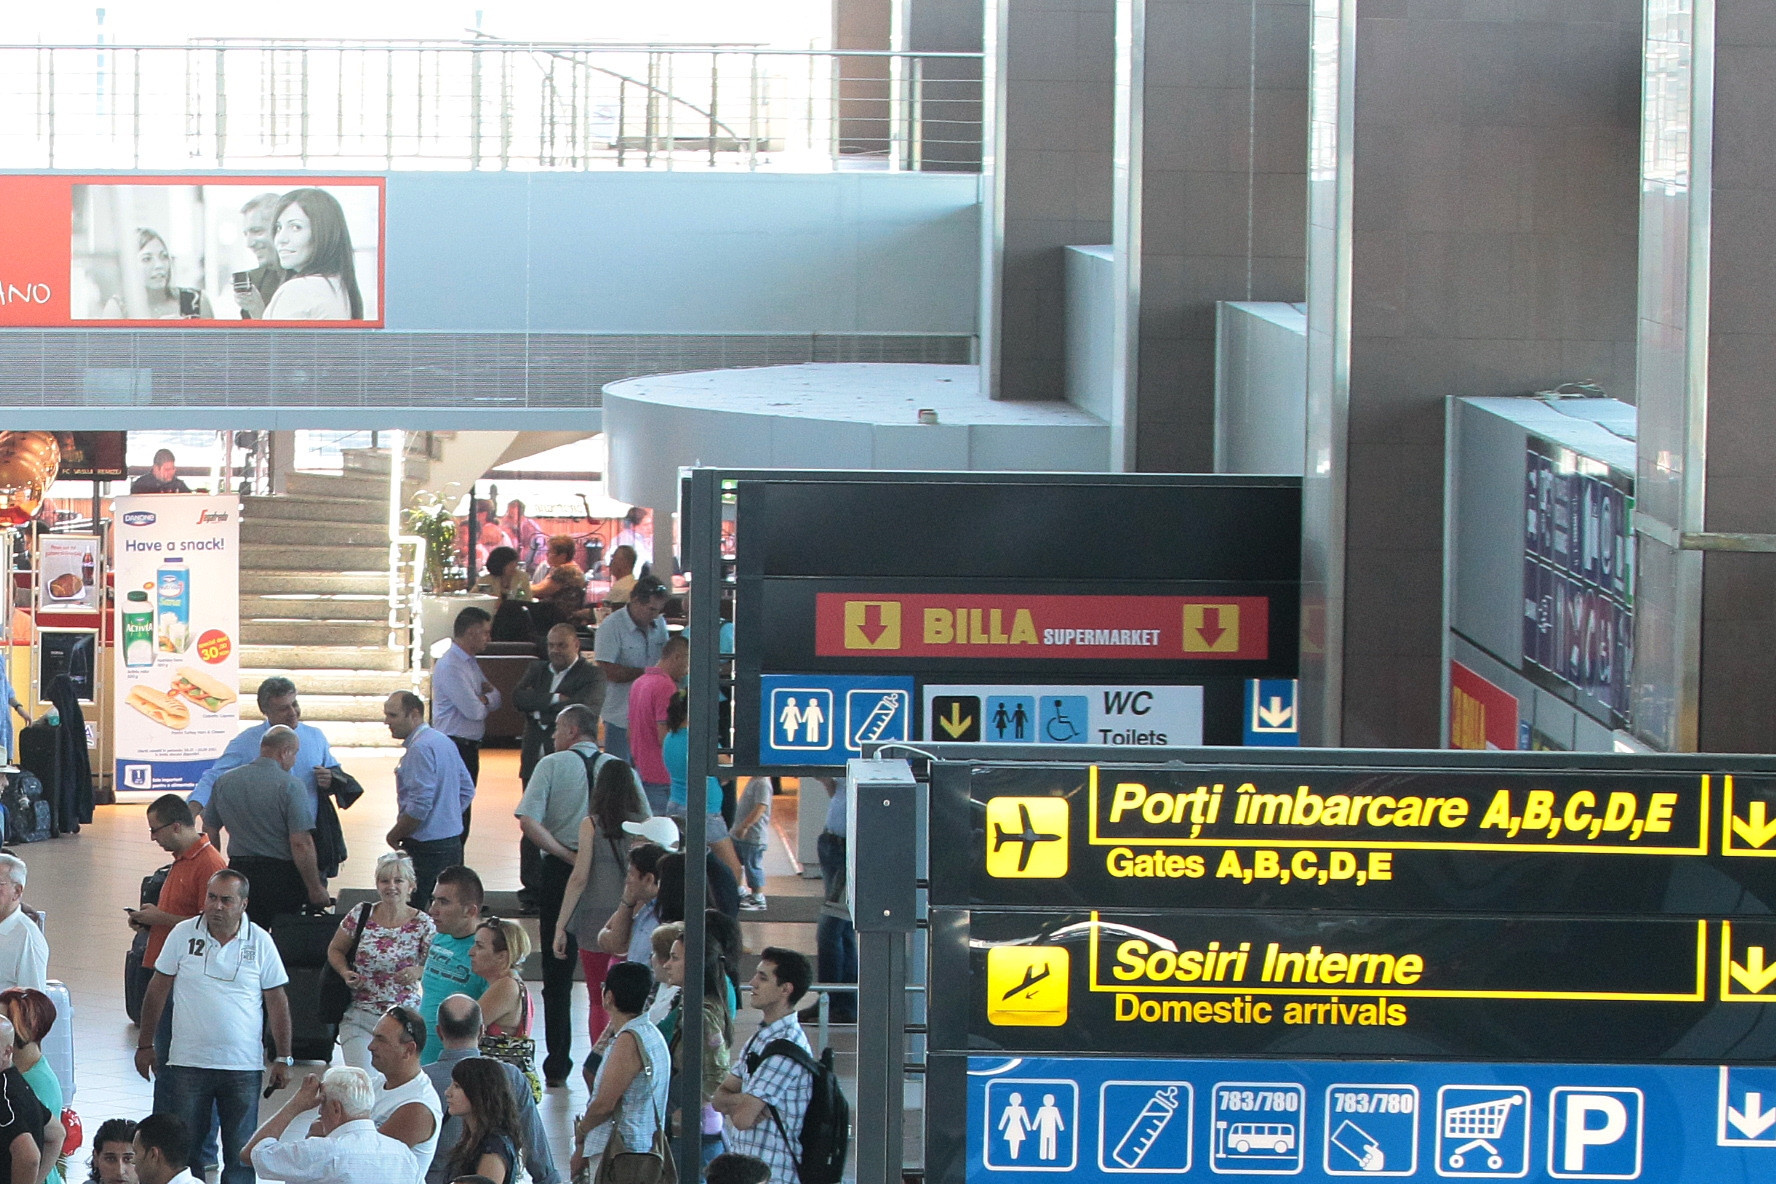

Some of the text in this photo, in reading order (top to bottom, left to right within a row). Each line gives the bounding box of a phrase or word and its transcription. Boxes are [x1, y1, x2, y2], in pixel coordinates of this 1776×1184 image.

[126, 537, 225, 552] Have a snack!
[126, 622, 153, 633] ACTIVIA
[923, 607, 1161, 647] BILLA SUPERMARKET
[201, 645, 219, 661] 30
[1103, 690, 1152, 715] WC
[1099, 728, 1168, 746] Toilets
[1234, 782, 1467, 830] îmbarcare
[1480, 790, 1676, 839] A,B,C,D,E
[1106, 847, 1393, 885] Gates A,B,C,D,E
[188, 937, 206, 957] 12
[1112, 939, 1424, 986] Sosiri Interne
[1113, 994, 1408, 1028] Domestic arrivals
[1218, 1090, 1298, 1113] 783/780
[1333, 1092, 1413, 1115] 783/780
[1564, 1093, 1628, 1171] P
